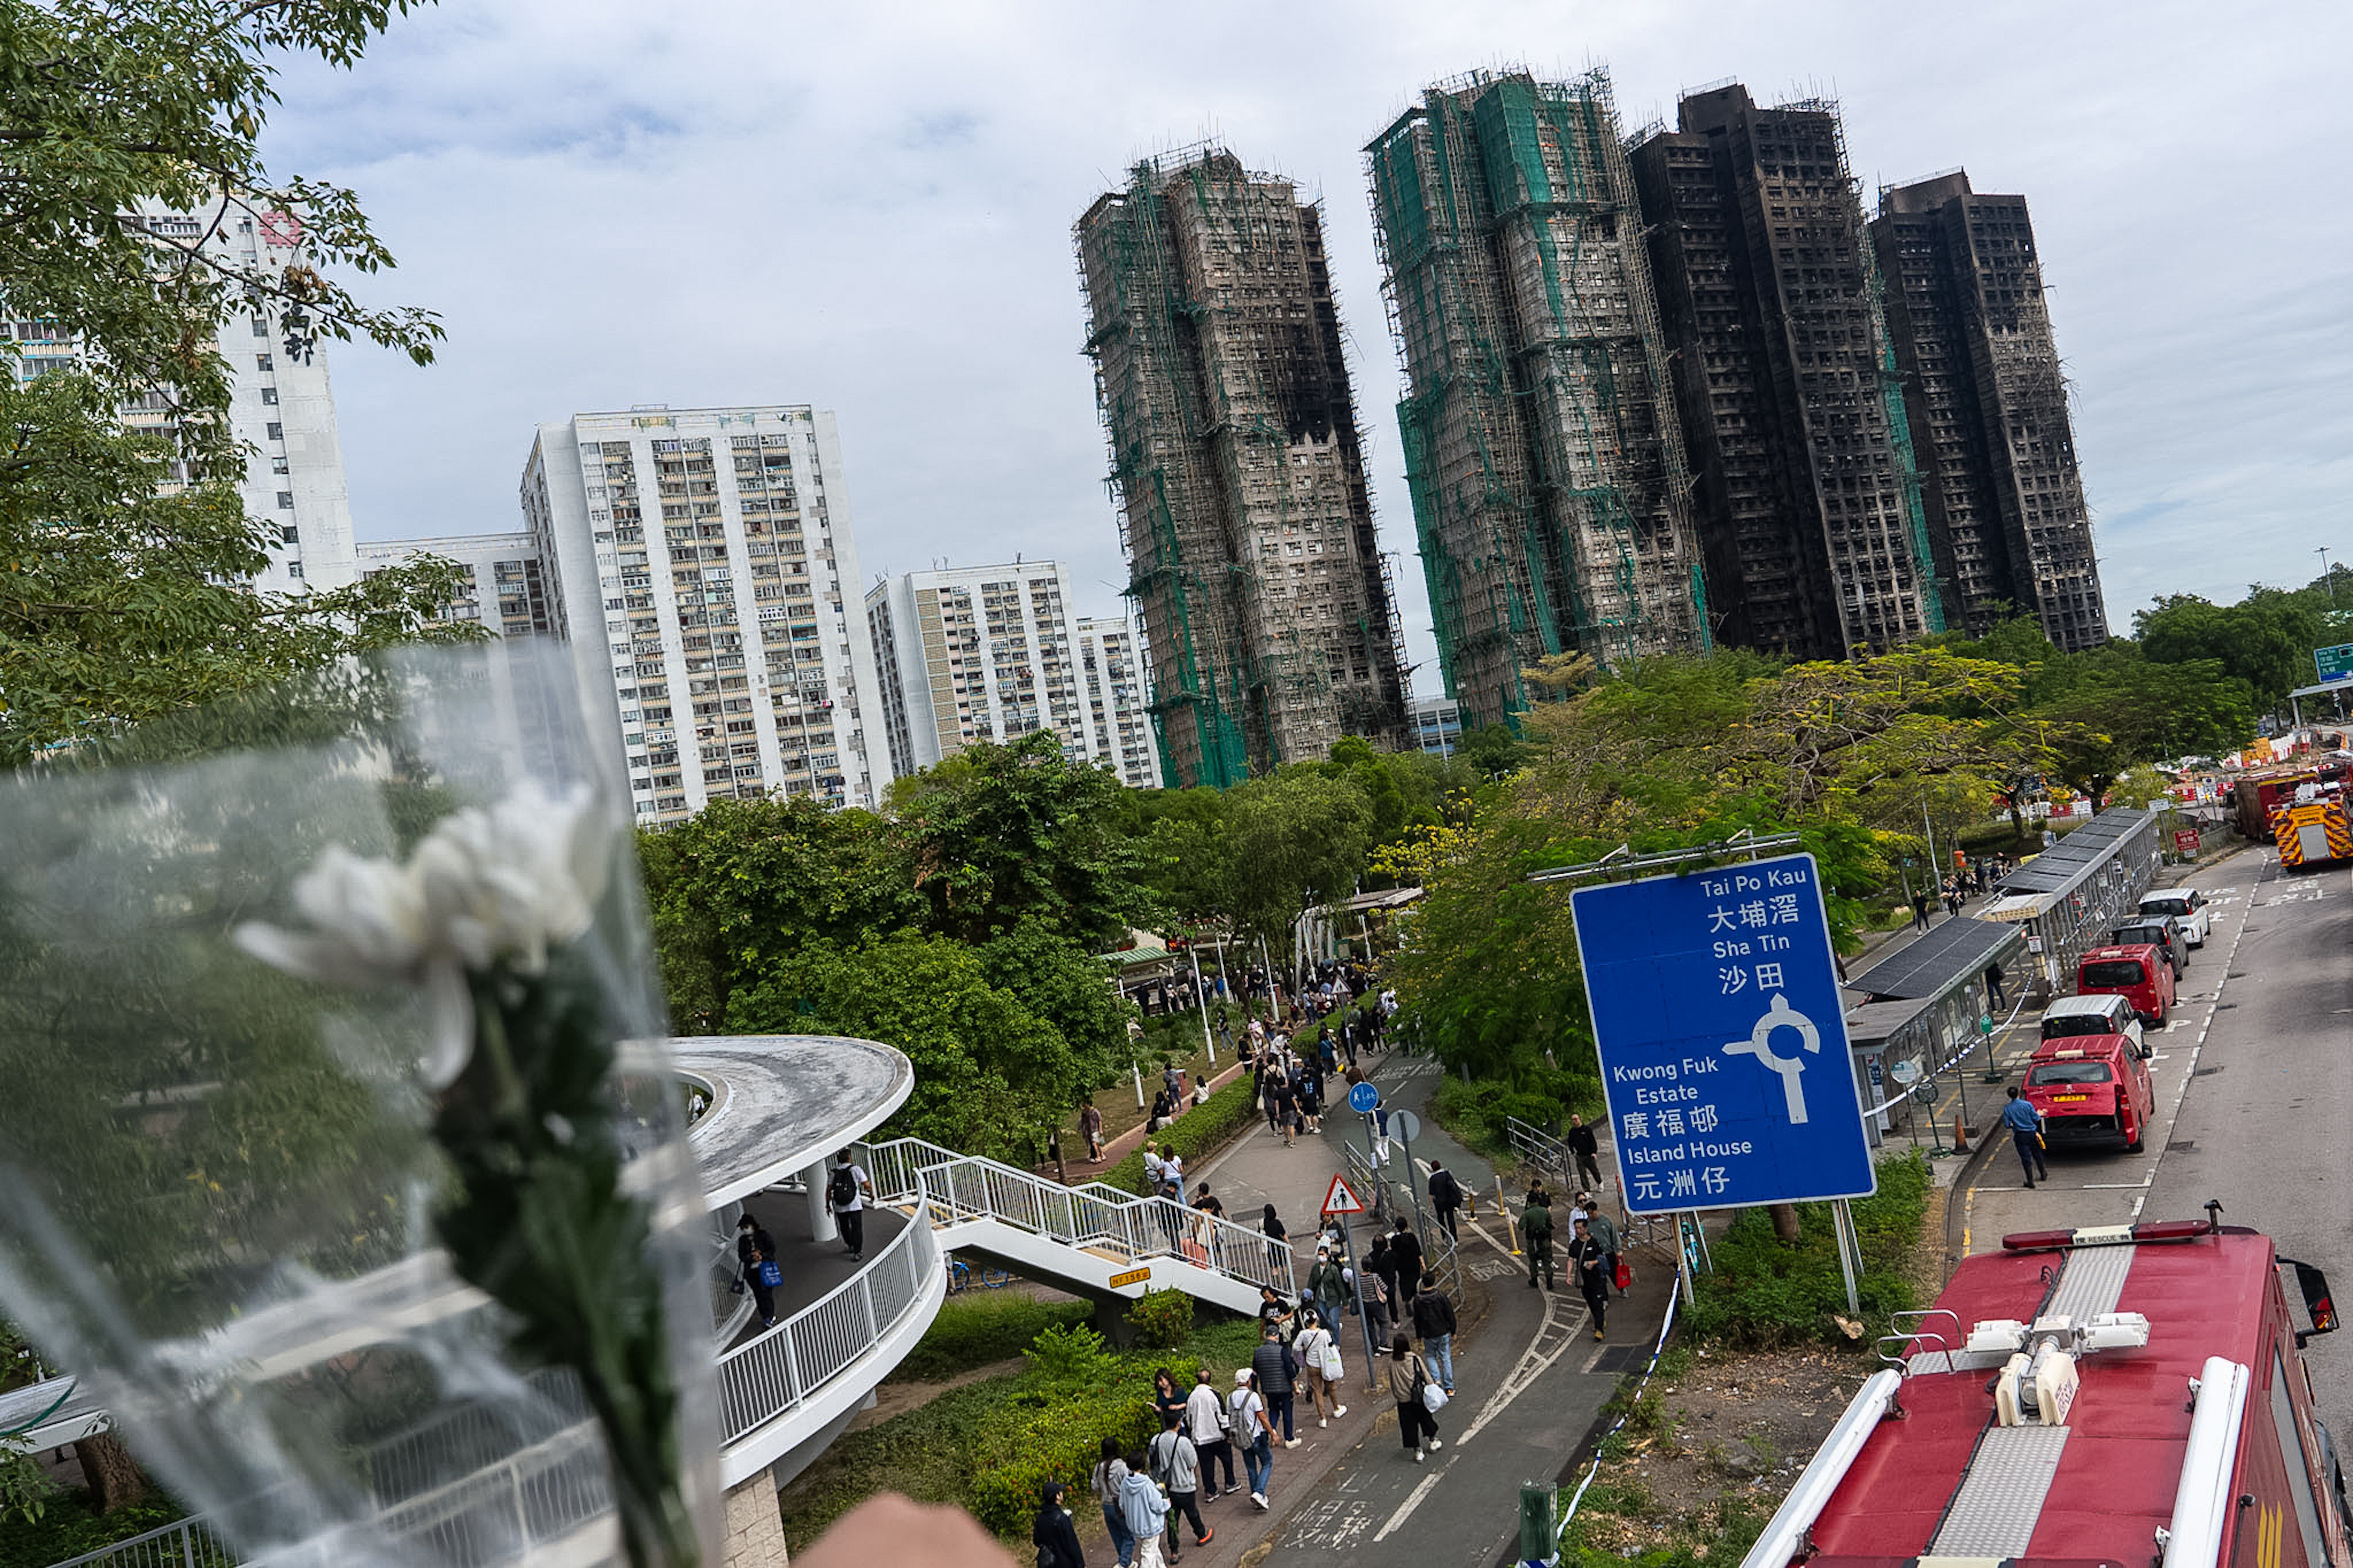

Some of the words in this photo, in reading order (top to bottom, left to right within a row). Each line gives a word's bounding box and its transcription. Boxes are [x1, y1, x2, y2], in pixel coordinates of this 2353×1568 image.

[1700, 878, 1730, 897] Tai
[1735, 875, 1761, 892] Po
[1767, 869, 1806, 888] Kau
[1707, 893, 1799, 933] 大埔滘
[1714, 940, 1751, 958] Sha
[1757, 934, 1790, 952] Tin
[1718, 963, 1784, 994] 沙田
[1614, 1065, 1677, 1082] Kwong
[1683, 1056, 1718, 1074] Fuk
[1636, 1085, 1698, 1105] Estate
[1623, 1104, 1718, 1139] 廣福邨
[1628, 1143, 1685, 1164] Island
[1690, 1141, 1752, 1158] House
[1634, 1166, 1730, 1200] 元洲仔
[2088, 1234, 2117, 1243] RESCUE
